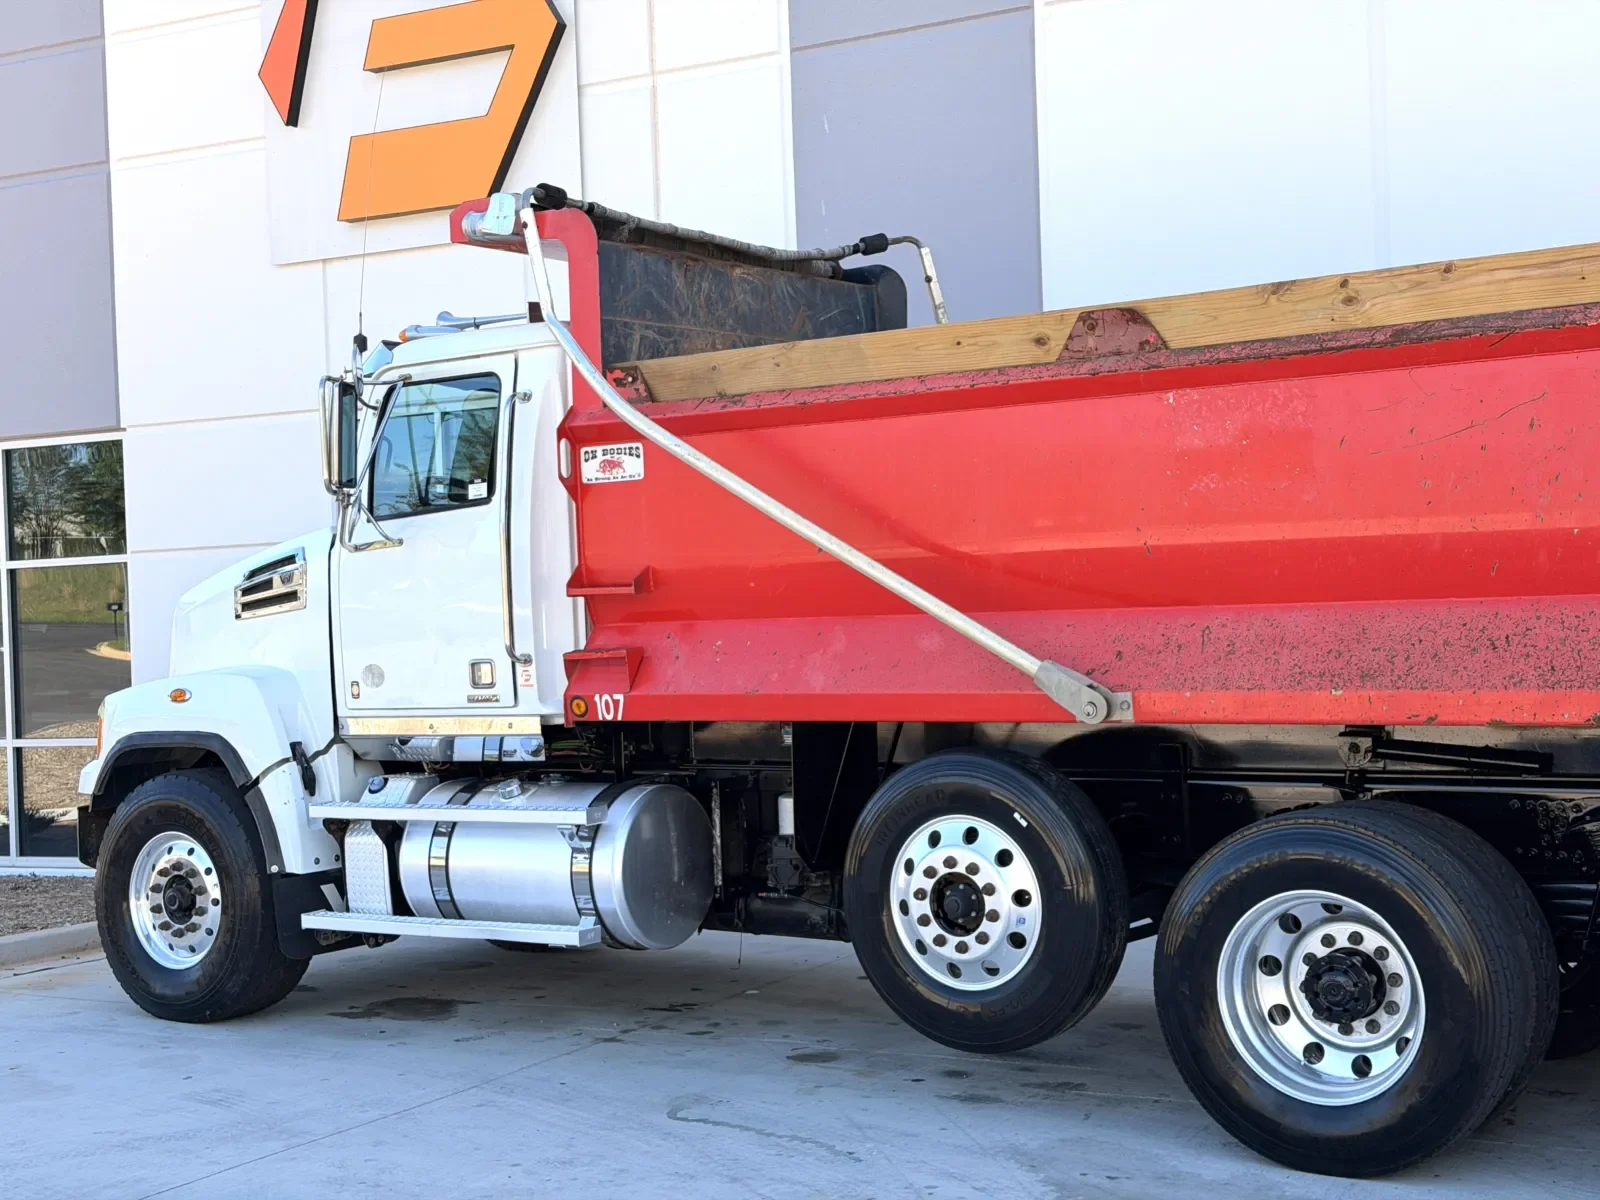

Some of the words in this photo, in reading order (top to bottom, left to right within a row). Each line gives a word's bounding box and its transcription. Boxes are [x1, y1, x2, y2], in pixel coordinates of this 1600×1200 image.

[584, 450, 597, 462] OX
[602, 446, 640, 458] BODIES
[594, 693, 624, 721] 107
[876, 788, 946, 847] IRONHEAD
